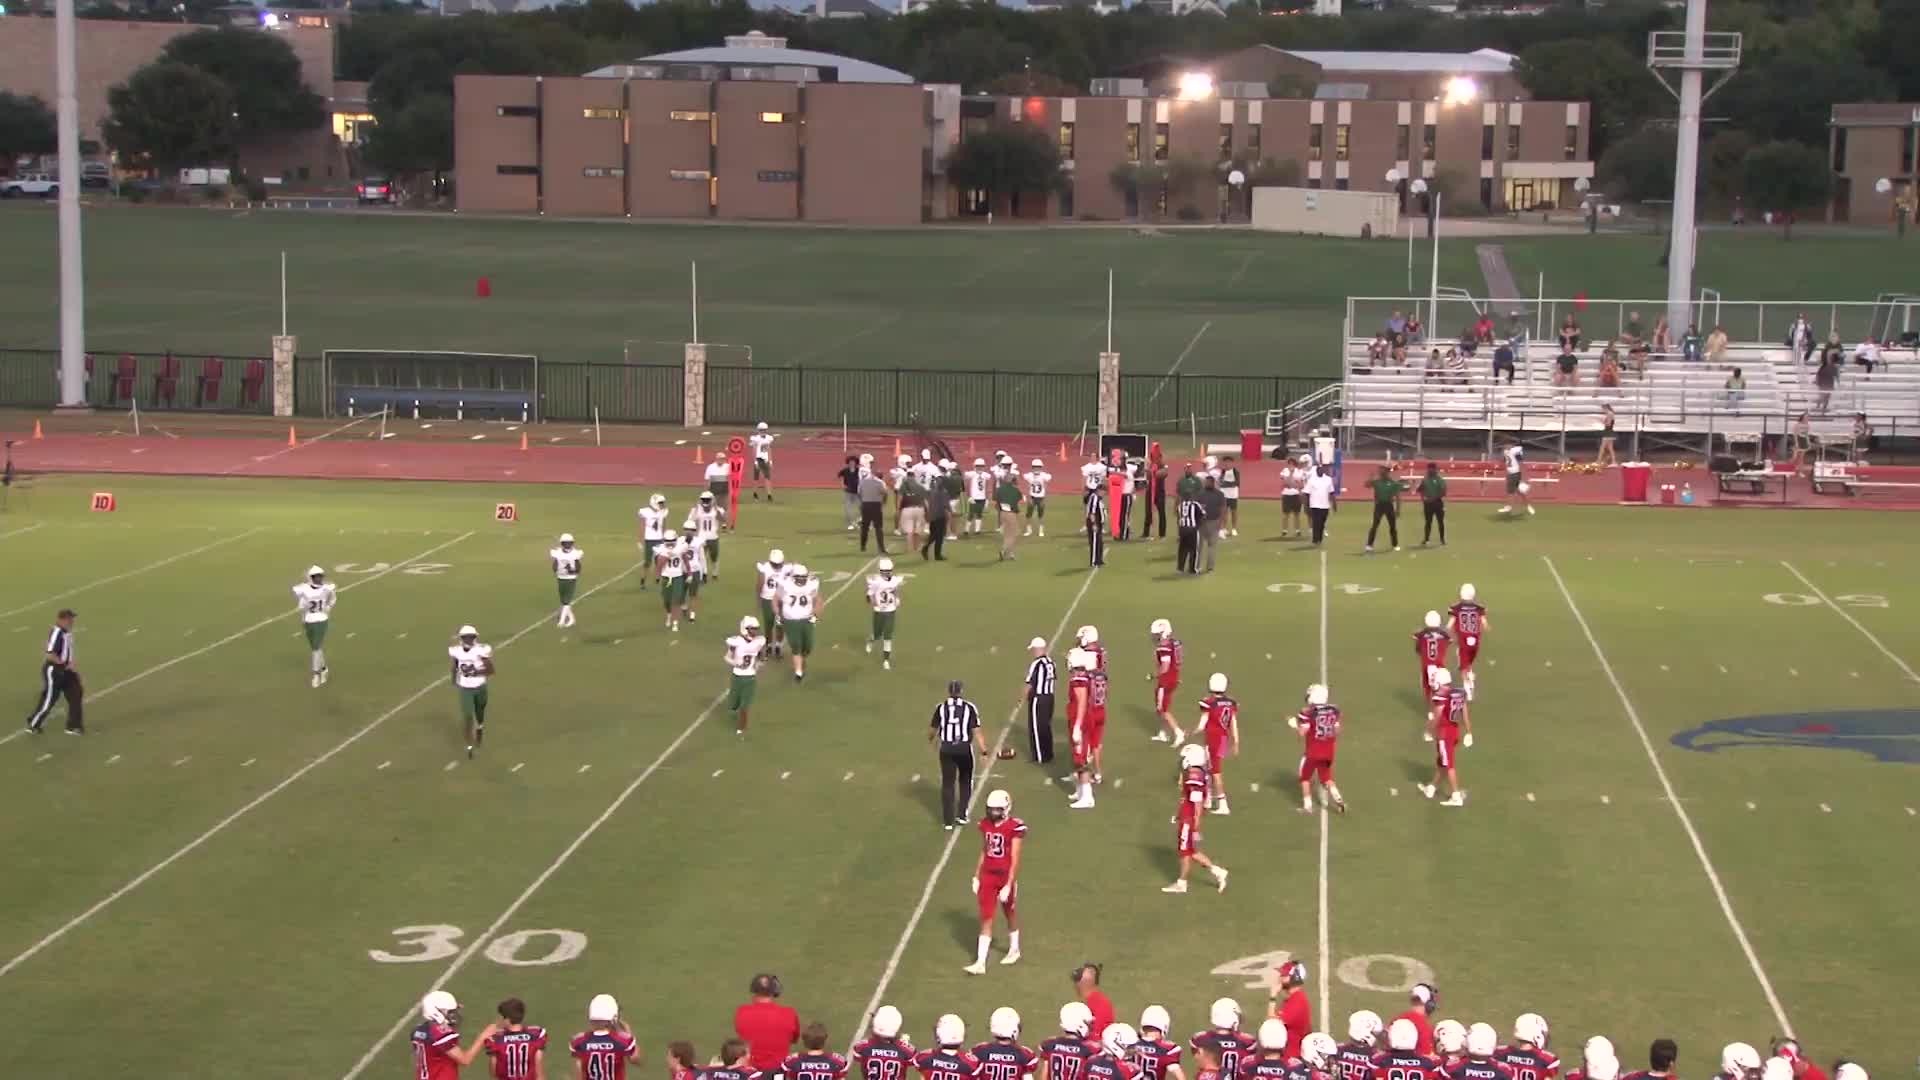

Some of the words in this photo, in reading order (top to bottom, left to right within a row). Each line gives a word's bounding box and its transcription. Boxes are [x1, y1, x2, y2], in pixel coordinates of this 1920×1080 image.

[95, 496, 109, 509] 10
[497, 506, 513, 519] 20
[309, 600, 323, 613] 21
[368, 924, 588, 967] 30
[1210, 950, 1427, 993] 40
[506, 1043, 530, 1078] 11
[588, 1052, 616, 1080] 41
[1051, 1053, 1082, 1080] 87
